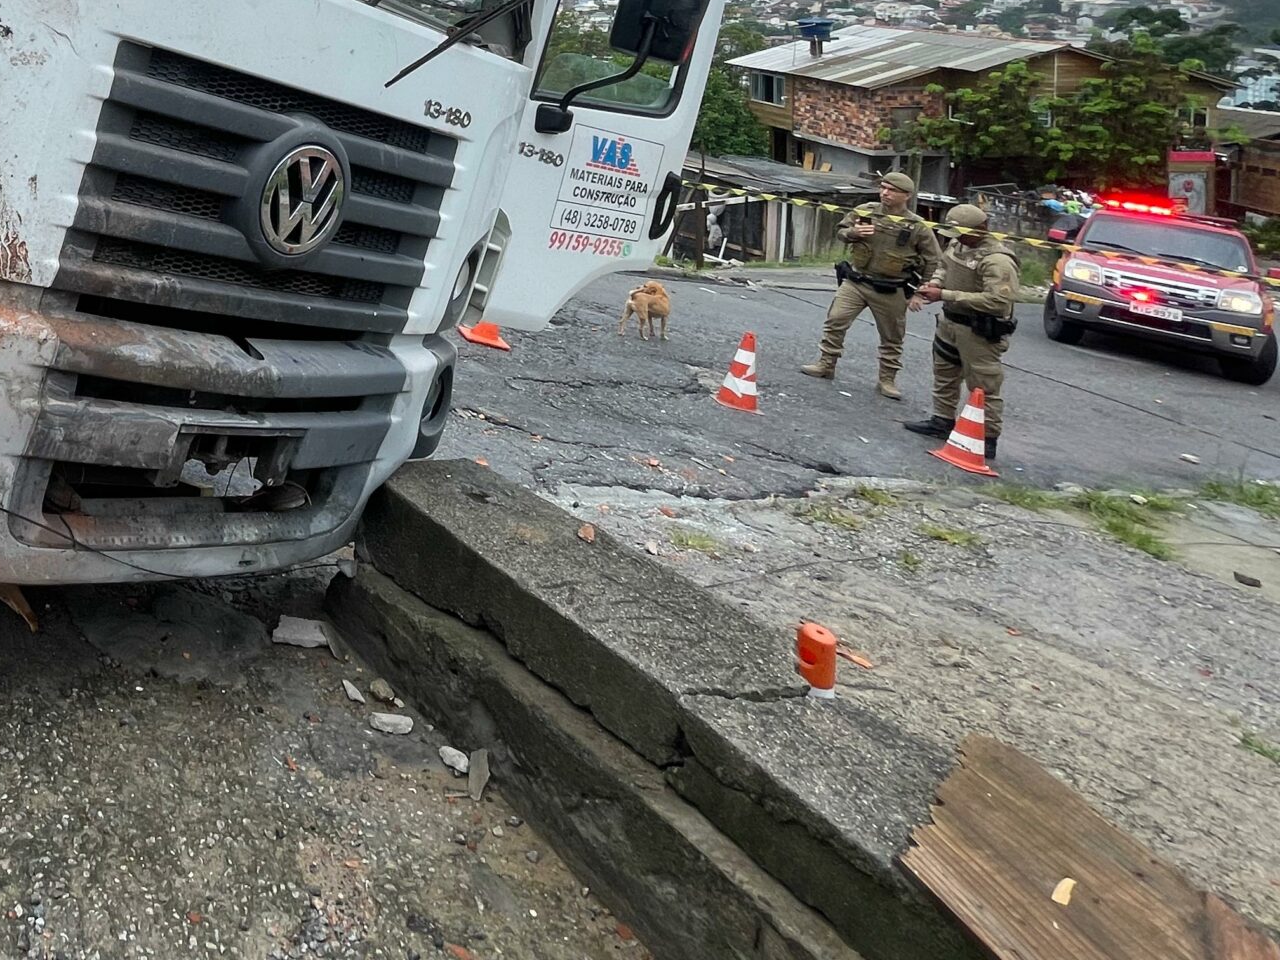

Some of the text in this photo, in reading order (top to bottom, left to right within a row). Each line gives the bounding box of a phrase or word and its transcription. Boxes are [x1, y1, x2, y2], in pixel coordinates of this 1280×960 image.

[423, 99, 472, 129] 13-180
[518, 141, 564, 168] 13-180
[592, 135, 632, 169] VAS
[569, 167, 649, 195] MATERIAIS PARA
[572, 185, 637, 209] CONSTRUÇÃO
[560, 208, 637, 234] (48) 3258-0789
[548, 230, 624, 257] 99159-9255
